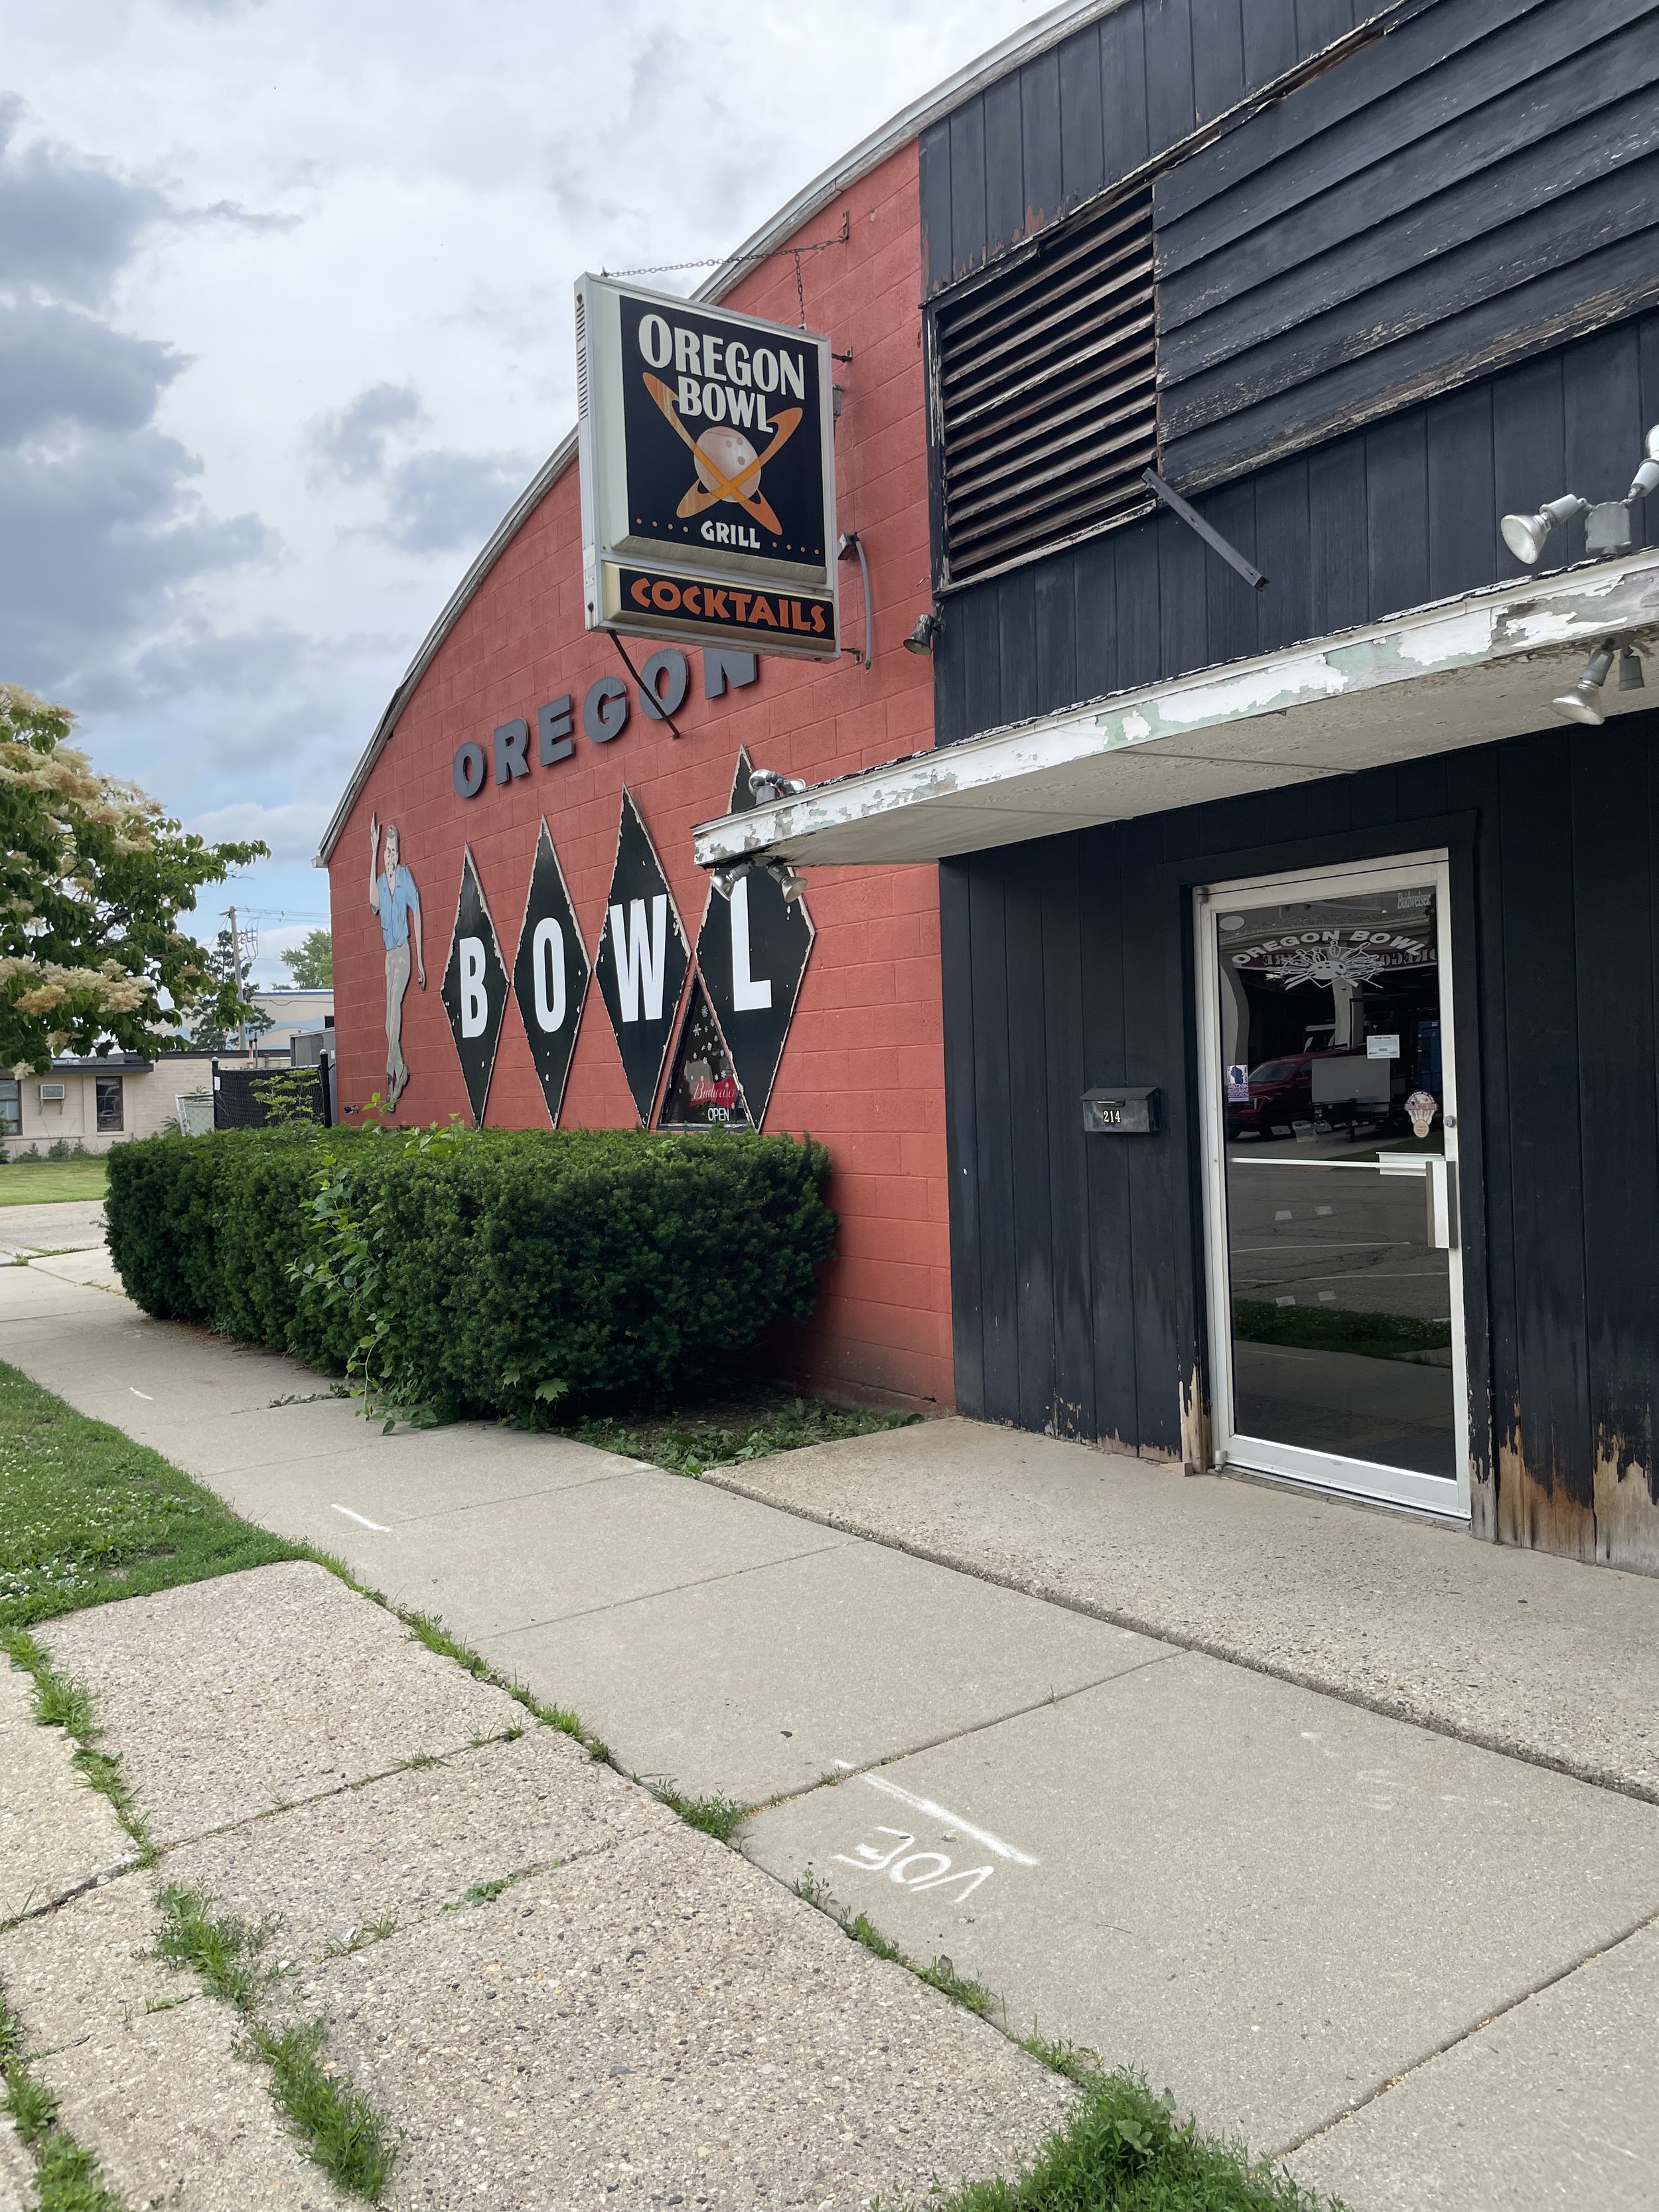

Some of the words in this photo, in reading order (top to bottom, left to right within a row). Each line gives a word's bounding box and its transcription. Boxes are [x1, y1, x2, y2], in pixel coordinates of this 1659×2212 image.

[638, 314, 804, 400] OREGON
[678, 376, 774, 433] BOWL
[701, 520, 760, 549] GRILL
[630, 577, 827, 634] COCKTAILS
[453, 647, 757, 797] OREGON
[459, 876, 772, 1038] BOWL
[1232, 930, 1340, 964] OREGON
[1349, 930, 1427, 956] BOWL
[693, 1082, 737, 1100] Budweiser
[707, 1108, 730, 1122] OPEN
[1104, 1110, 1121, 1123] 214
